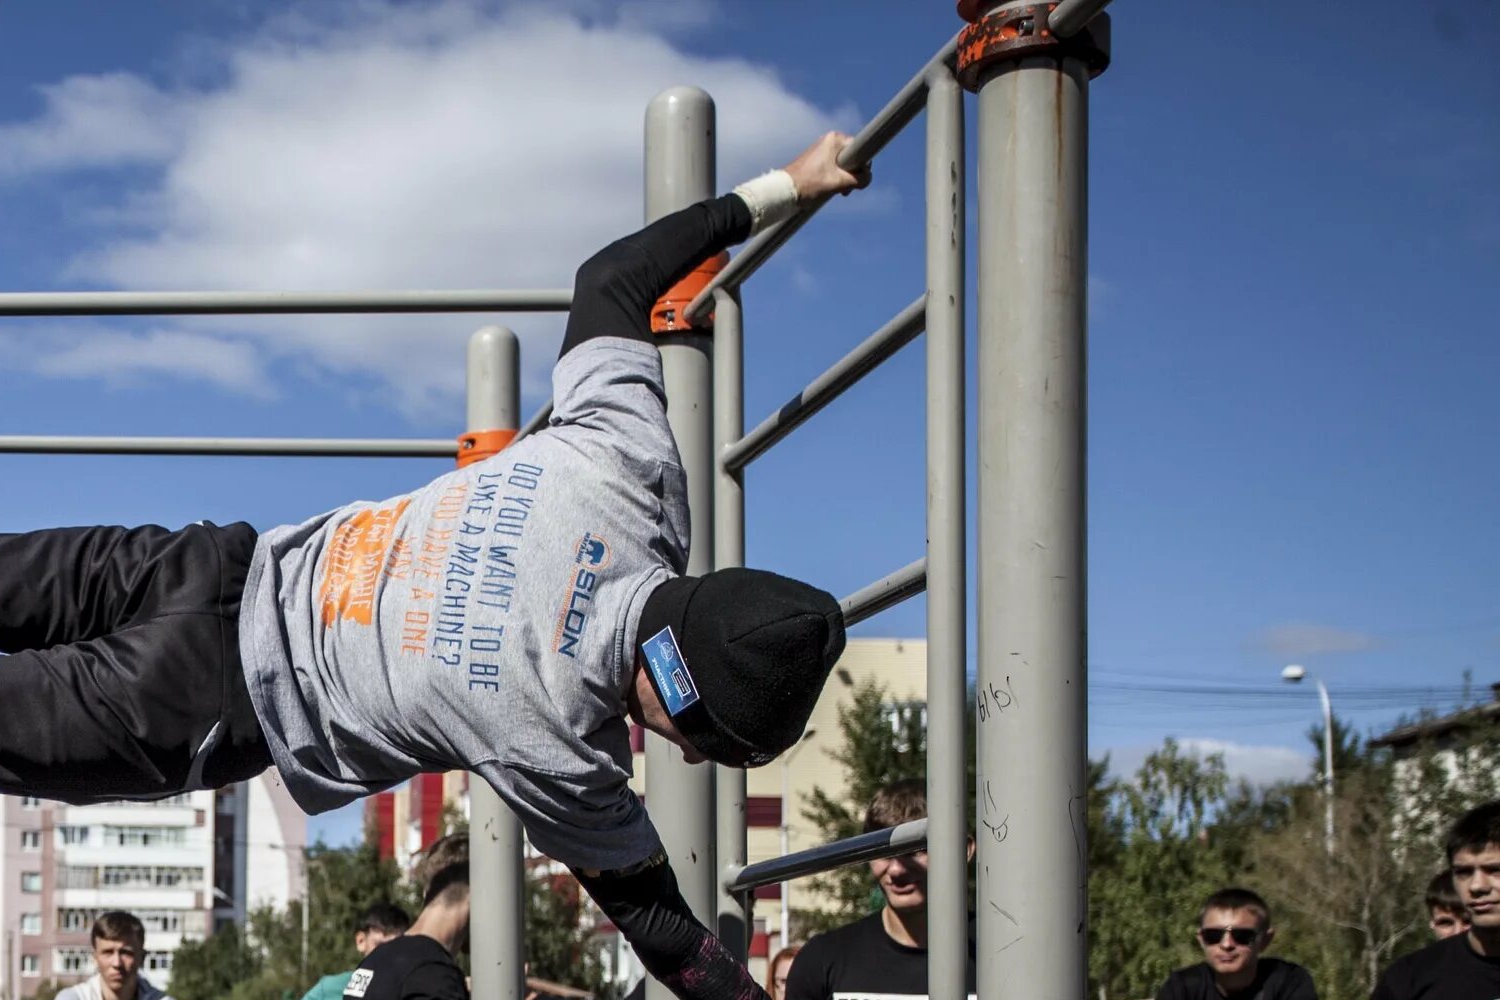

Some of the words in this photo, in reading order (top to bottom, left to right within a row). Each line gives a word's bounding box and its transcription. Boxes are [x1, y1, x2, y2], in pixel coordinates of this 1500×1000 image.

[466, 473, 502, 515] LIKE
[508, 463, 544, 491] DO
[431, 483, 468, 521] YOU
[493, 496, 534, 537] YOU
[459, 521, 486, 535] A
[412, 527, 453, 580] HAVE
[411, 587, 435, 600] A
[476, 545, 519, 613] WANT
[431, 541, 481, 666] MACHINE?
[558, 568, 596, 658] SLON
[402, 611, 430, 657] ONE
[469, 625, 504, 653] TO
[468, 663, 499, 693] BE
[652, 657, 671, 698] УЧАСТНИК
